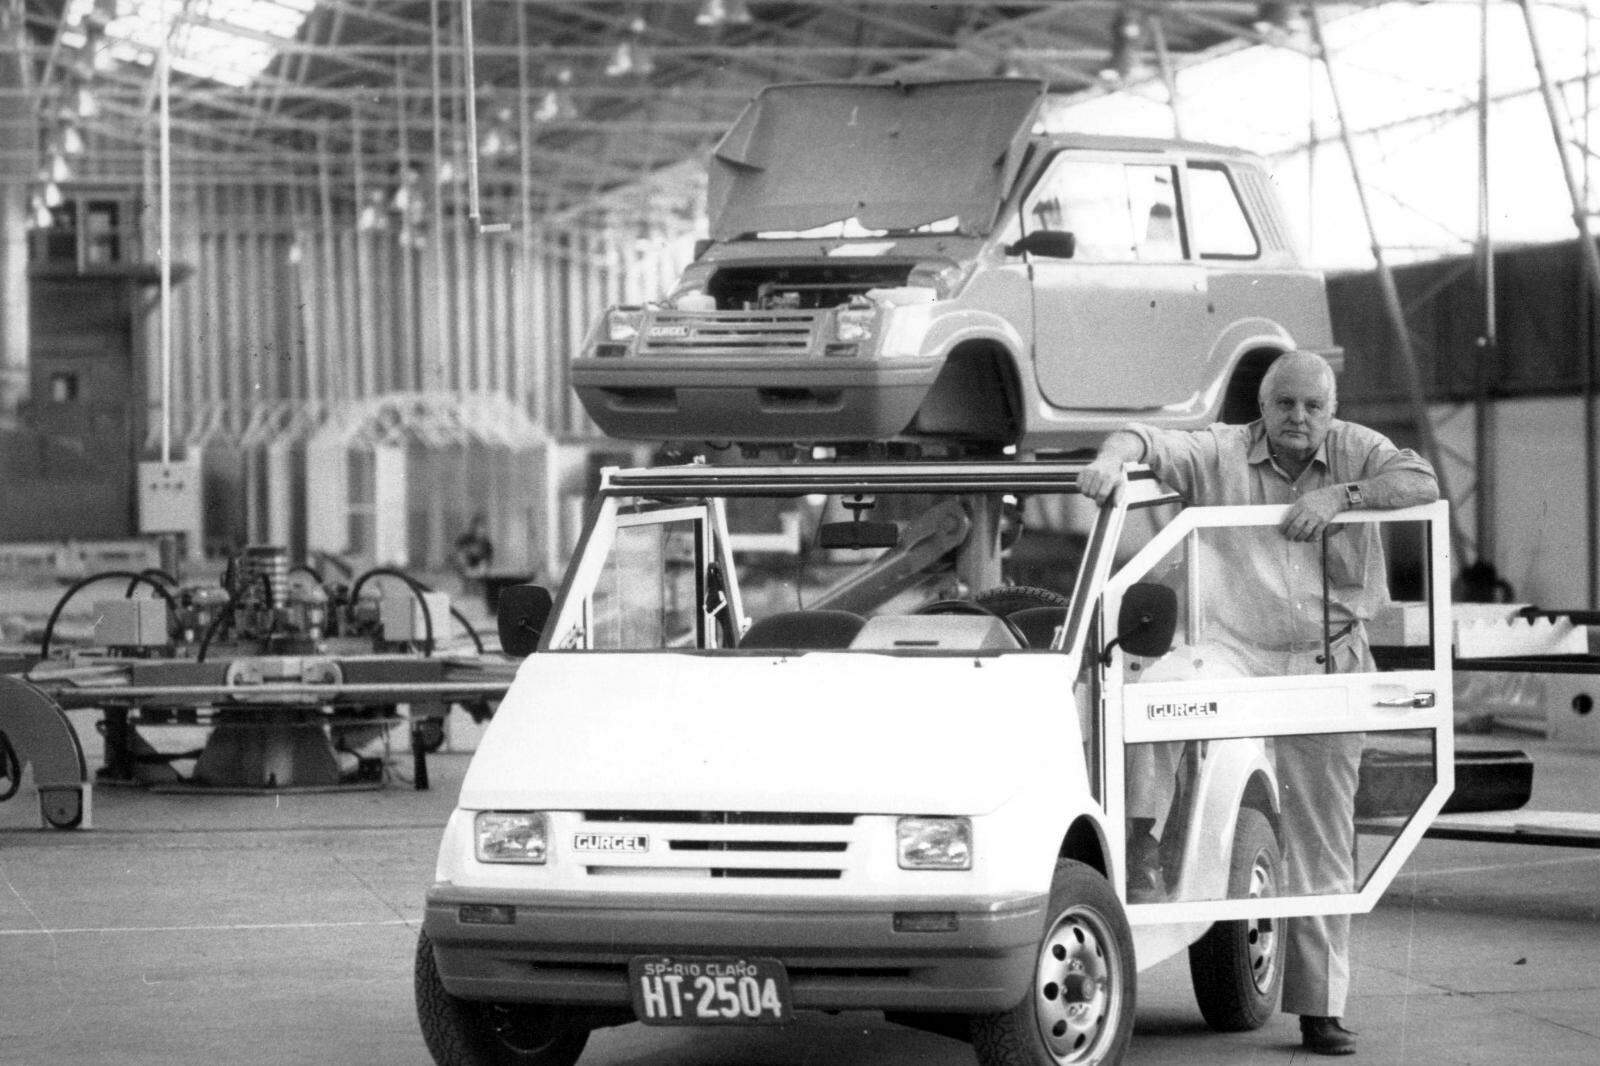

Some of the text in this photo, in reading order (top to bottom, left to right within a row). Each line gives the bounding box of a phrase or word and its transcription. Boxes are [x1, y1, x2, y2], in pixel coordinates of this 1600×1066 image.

[1149, 702, 1217, 718] GURGEL
[575, 834, 646, 851] GURGEL
[705, 963, 758, 976] CLARO
[641, 975, 782, 1018] HT-2504
